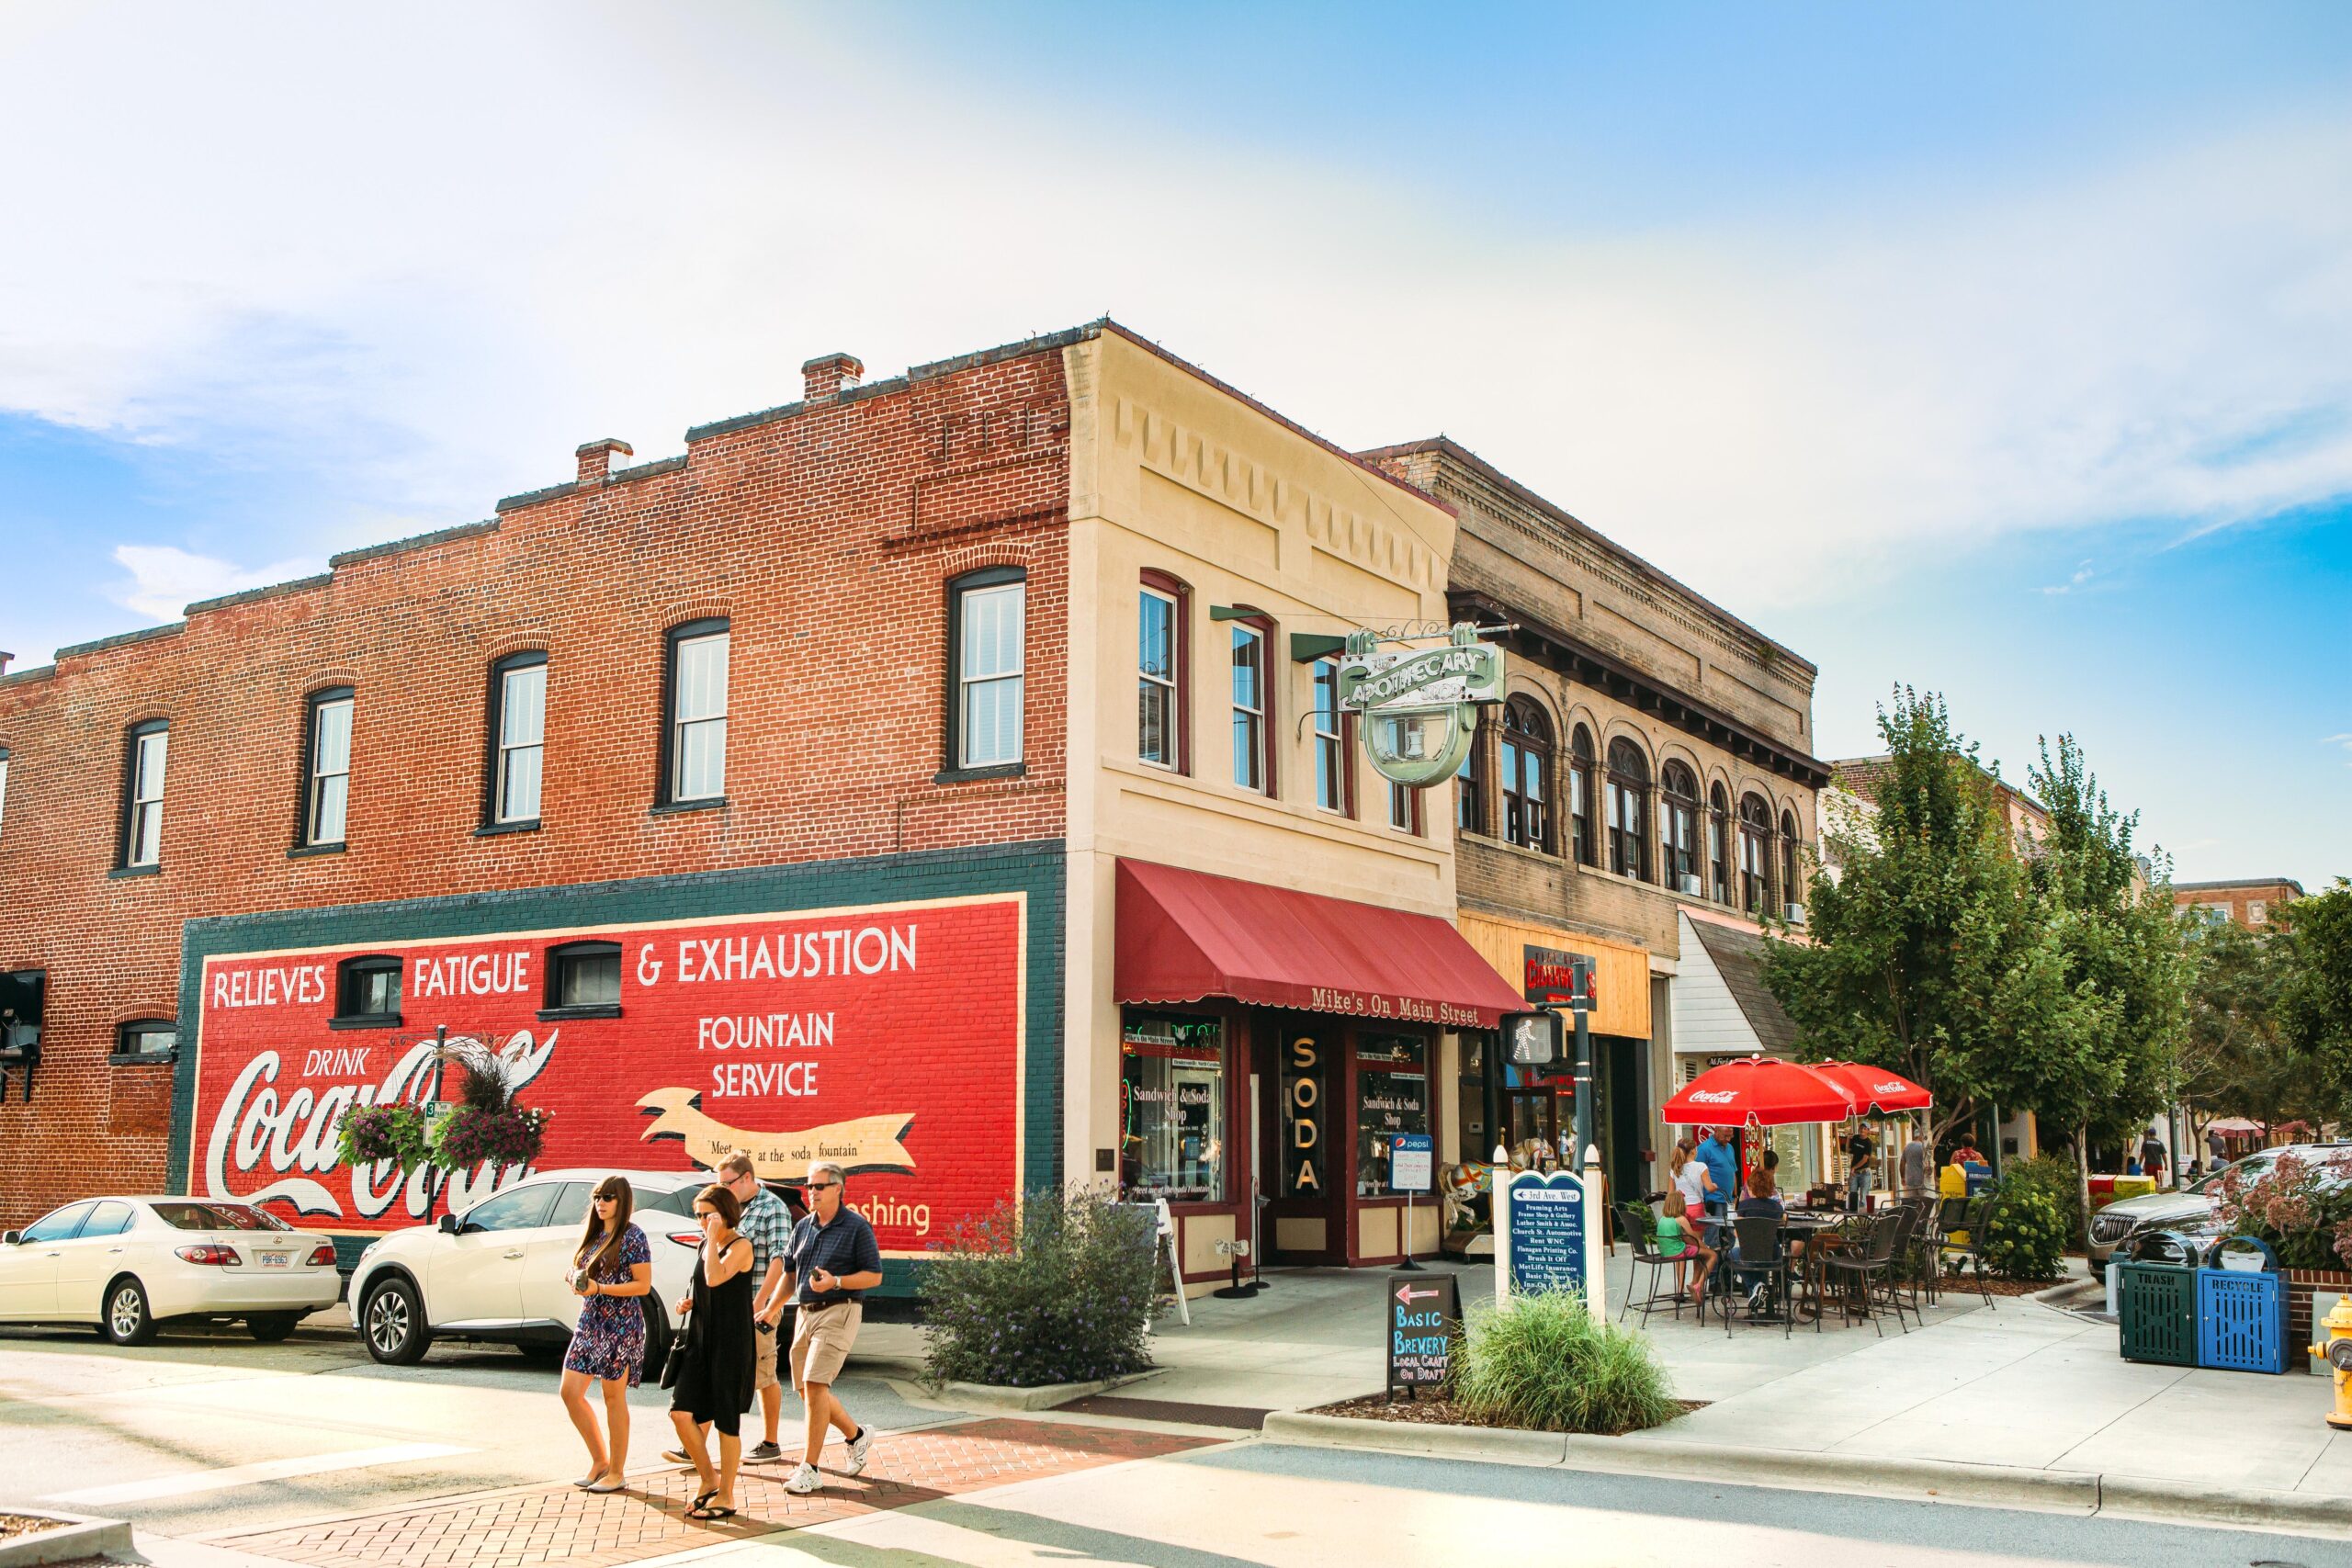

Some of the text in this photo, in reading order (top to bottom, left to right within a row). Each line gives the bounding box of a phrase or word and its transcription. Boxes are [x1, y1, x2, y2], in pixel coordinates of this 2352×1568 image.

[1351, 652, 1480, 703] APOTHECARY
[1420, 682, 1462, 700] SHOP
[213, 924, 917, 1008] RELIEVES FATIGUE & EXHAUSTION
[1311, 987, 1478, 1023] Mike's On Main Street
[697, 1010, 835, 1050] FOUNTAIN
[303, 1047, 371, 1077] DRINK
[712, 1061, 819, 1098] SERVICE
[1873, 1080, 1909, 1094] Coca-Cola
[1134, 1086, 1212, 1103] Sandwich & Soda
[1689, 1089, 1741, 1103] Coca-Cola
[428, 1104, 434, 1115] 3
[1363, 1096, 1419, 1111] Sandwich & Soda
[1165, 1107, 1186, 1124] Shop
[1385, 1113, 1401, 1129] Shop
[1408, 1140, 1429, 1149] pepsi
[757, 1149, 766, 1162] at
[770, 1148, 785, 1162] the
[791, 1145, 811, 1160] soda
[1528, 1190, 1577, 1201] 3rd Ave. West
[1526, 1203, 1553, 1213] Framing
[1544, 1246, 1567, 1255] Printing
[1545, 1264, 1577, 1272] Insurance
[1544, 1273, 1570, 1281] Brery
[2137, 1273, 2176, 1286] TRASH
[1548, 1281, 1572, 1290] Crch
[2211, 1279, 2264, 1293] RECYCLE
[1396, 1304, 1442, 1328] BASIC
[1394, 1329, 1449, 1356] BREWERY
[1393, 1354, 1449, 1368] LOCAL CRAFT
[1417, 1368, 1446, 1381] DRAFT
